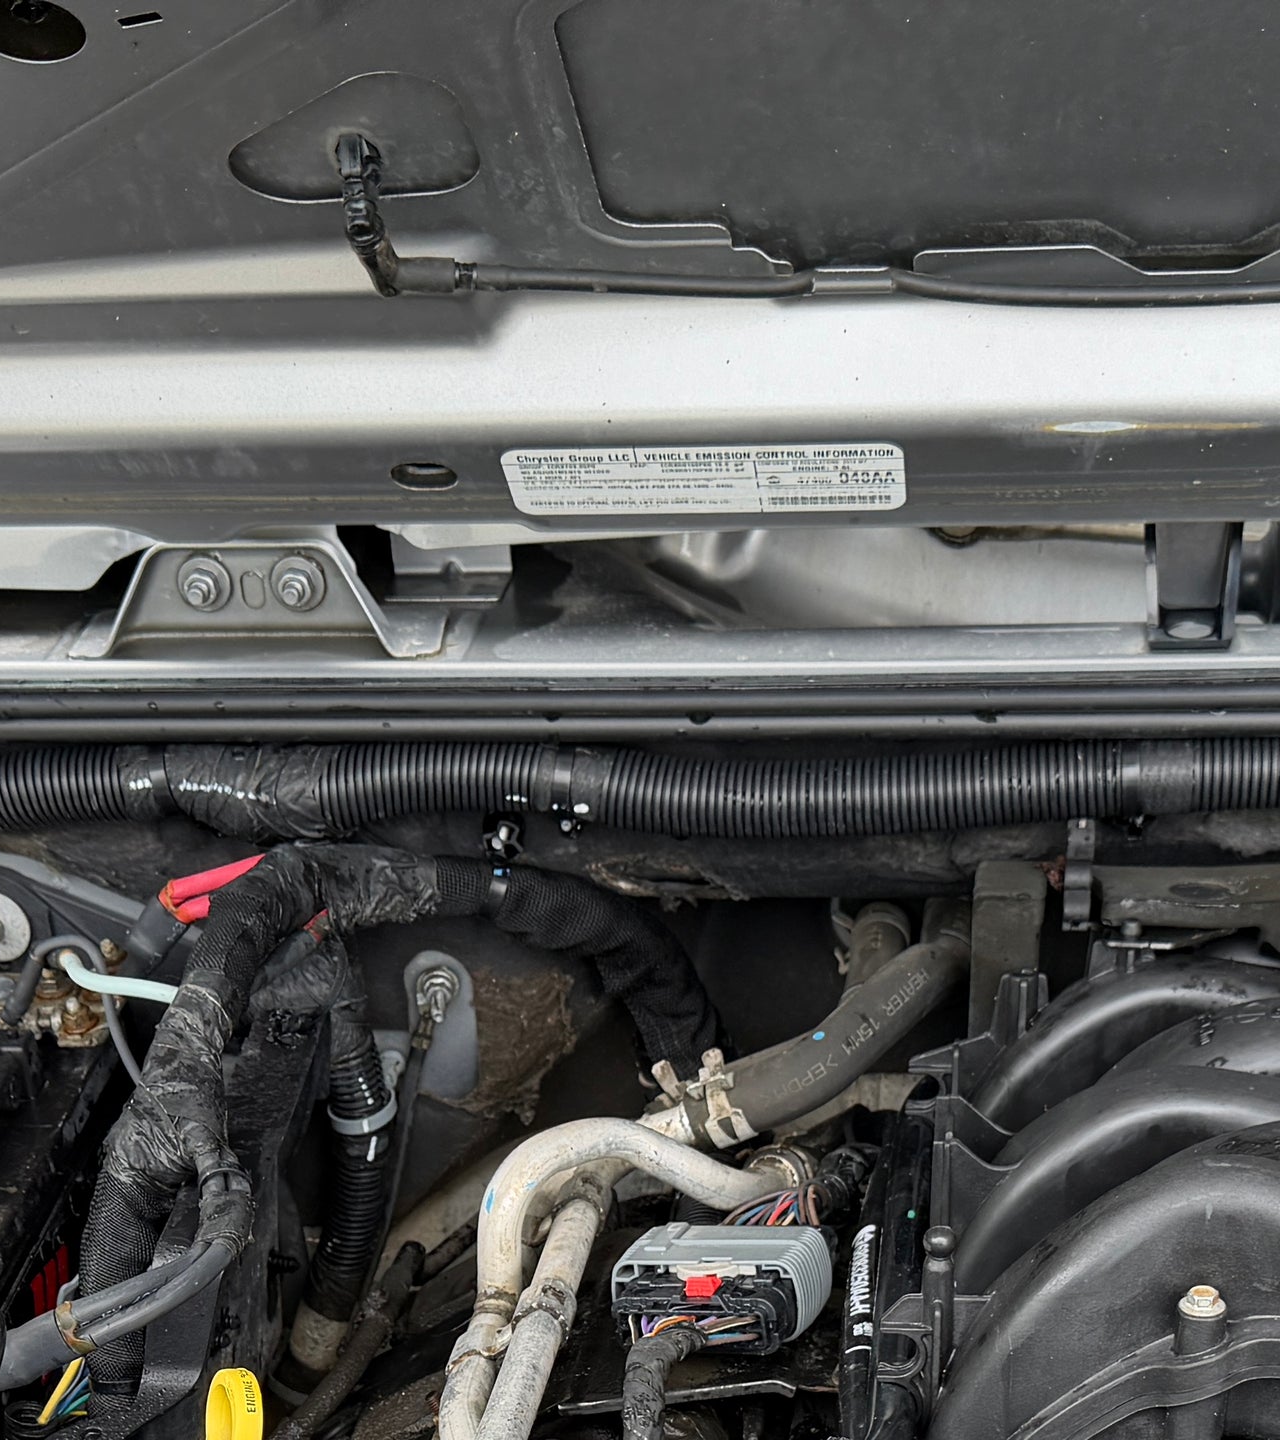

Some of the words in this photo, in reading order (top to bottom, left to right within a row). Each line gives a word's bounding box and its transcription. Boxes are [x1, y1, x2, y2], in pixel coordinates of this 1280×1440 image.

[517, 455, 564, 464] Chrysler
[569, 454, 604, 464] Group
[609, 453, 630, 462] LLC
[644, 453, 692, 461] VEHICLE
[696, 452, 751, 460] EMISSION
[755, 450, 809, 459] CONTROL
[813, 449, 894, 458] INFORMATION
[880, 967, 931, 1018] HEATER
[839, 1014, 883, 1057] 15MM
[243, 1381, 256, 1412] ENGINE
